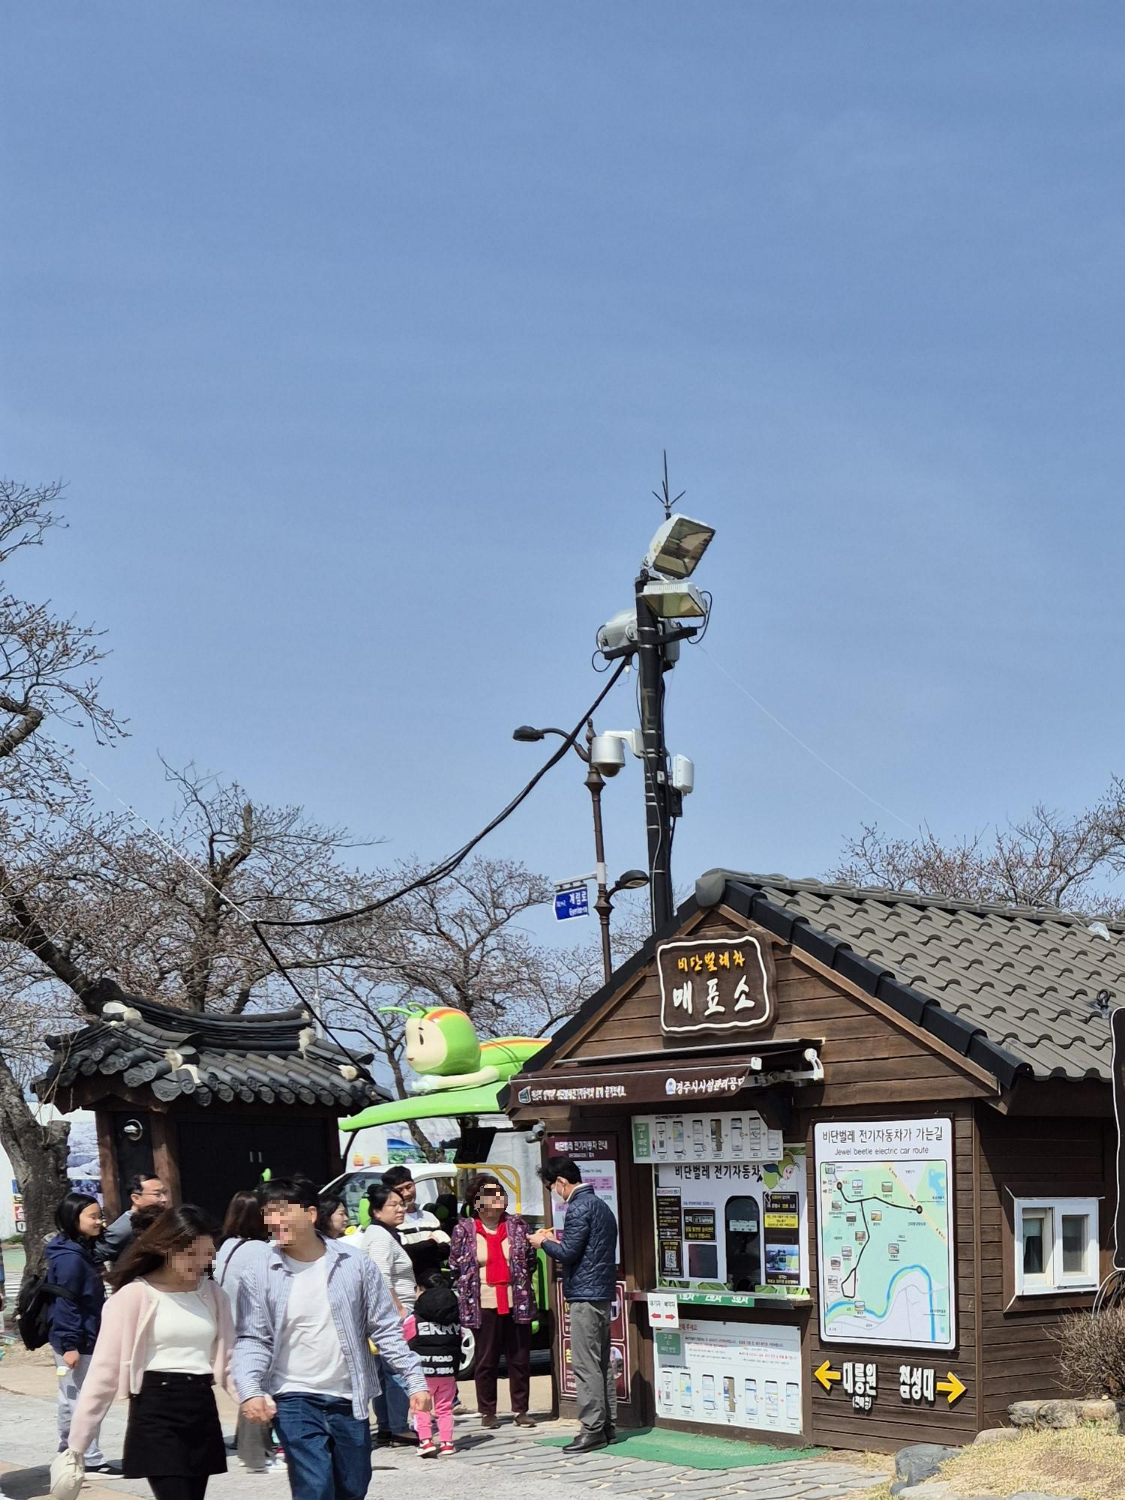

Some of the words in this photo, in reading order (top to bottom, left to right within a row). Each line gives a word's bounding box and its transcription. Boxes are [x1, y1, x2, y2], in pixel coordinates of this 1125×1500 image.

[678, 950, 746, 972] 비단벌레차
[672, 974, 756, 1016] 매표소
[822, 1130, 855, 1144] 비단벌레
[859, 1128, 912, 1142] 전기자동차가
[916, 1126, 942, 1141] 가는길
[675, 1165, 710, 1180] 비단벌레
[714, 1164, 760, 1180] 전기자동차
[418, 1322, 460, 1335] ERRY
[843, 1362, 877, 1396] 대릉원
[900, 1365, 934, 1401] 첨성대
